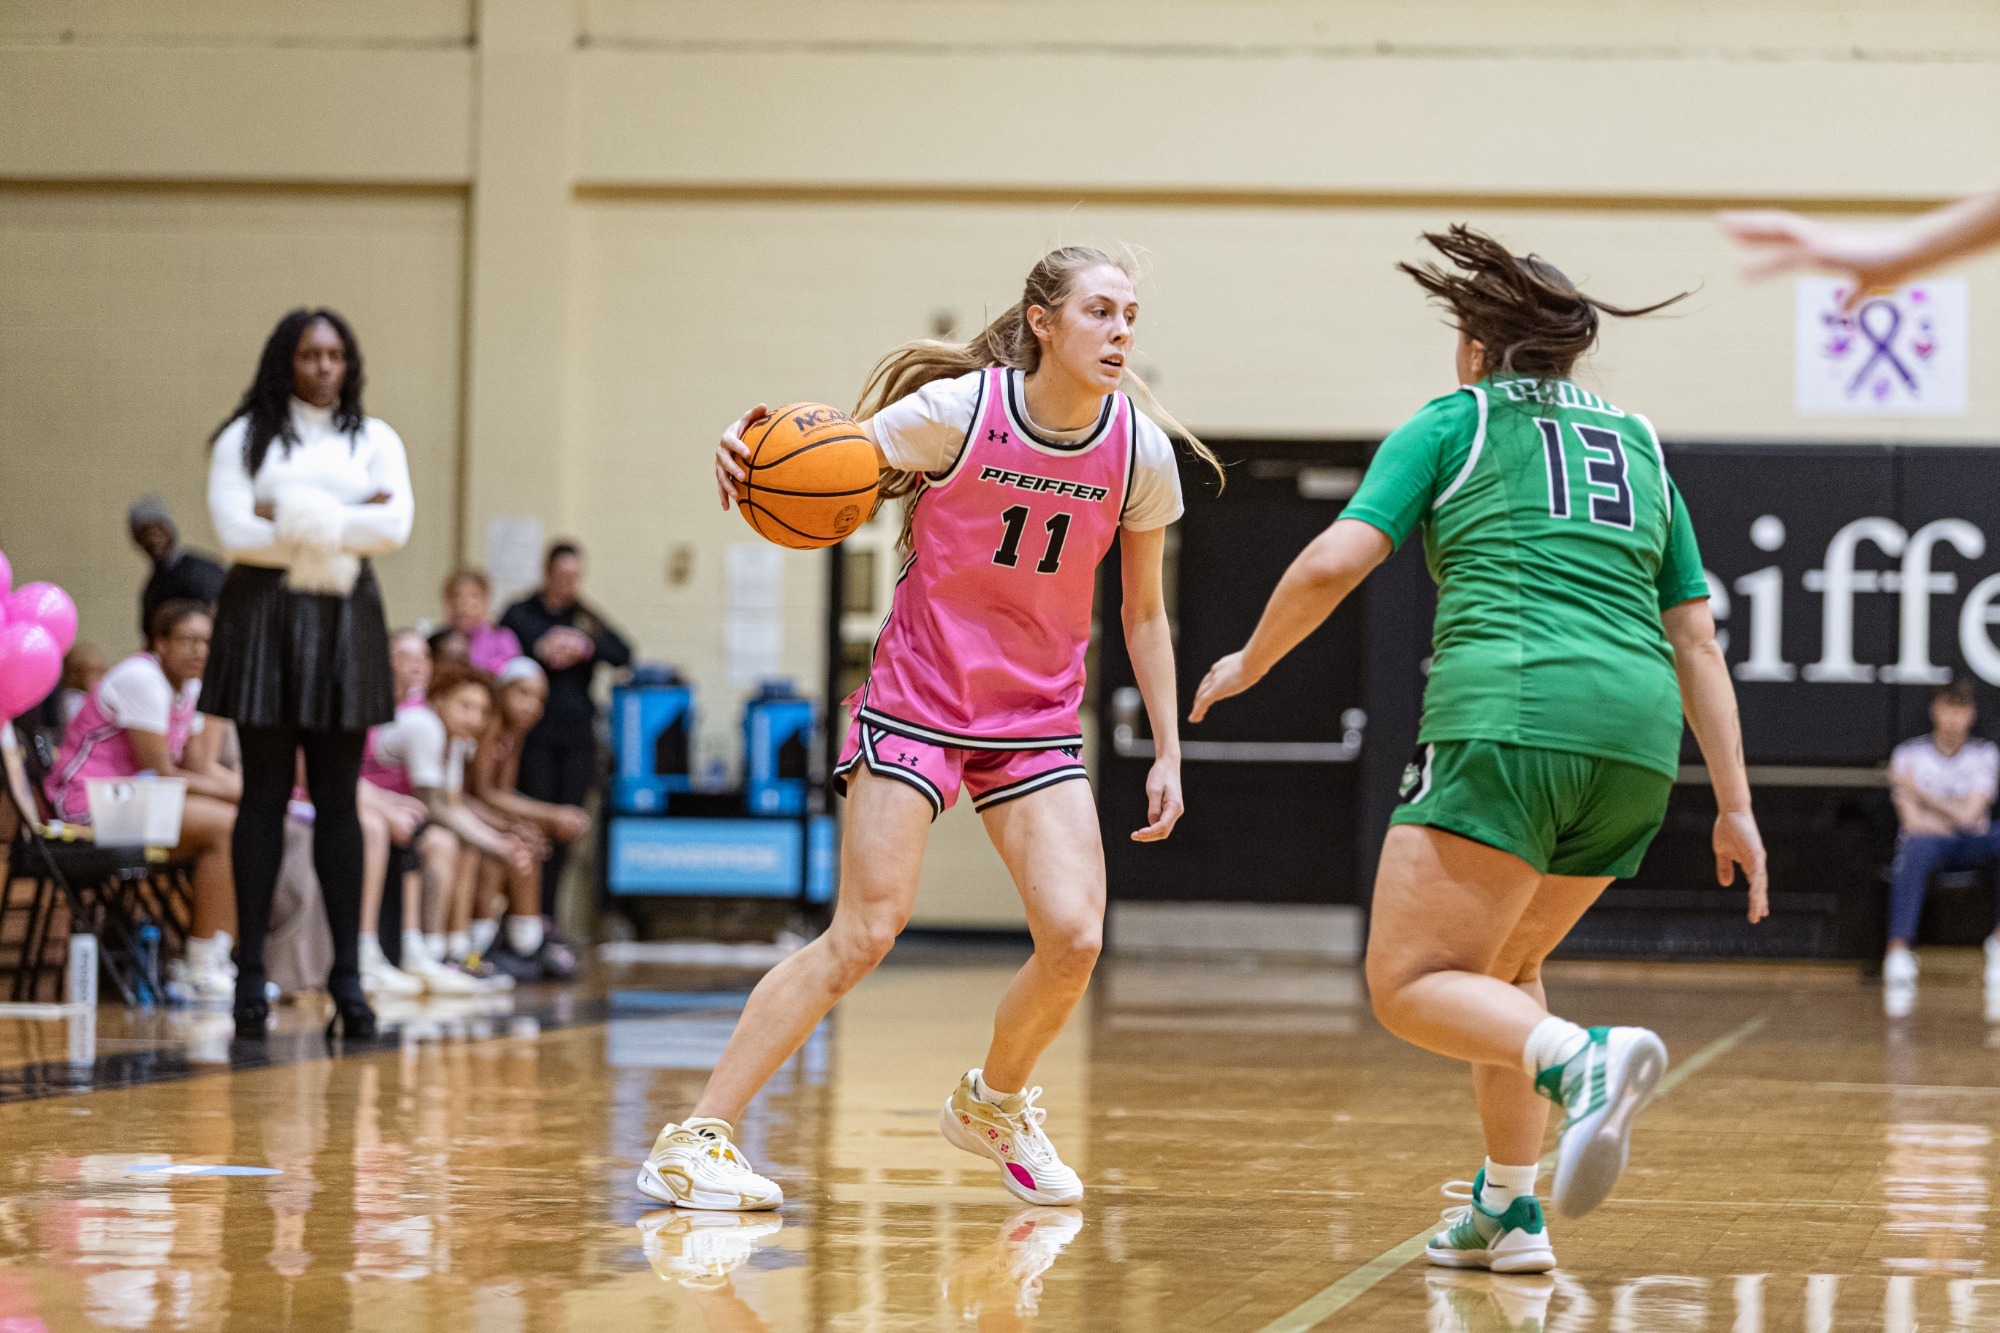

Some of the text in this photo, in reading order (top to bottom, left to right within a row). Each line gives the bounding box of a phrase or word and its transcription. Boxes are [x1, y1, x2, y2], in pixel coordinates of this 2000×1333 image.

[978, 465, 1110, 503] PFEIFFER
[1532, 417, 1635, 532] 13
[991, 503, 1073, 575] 11
